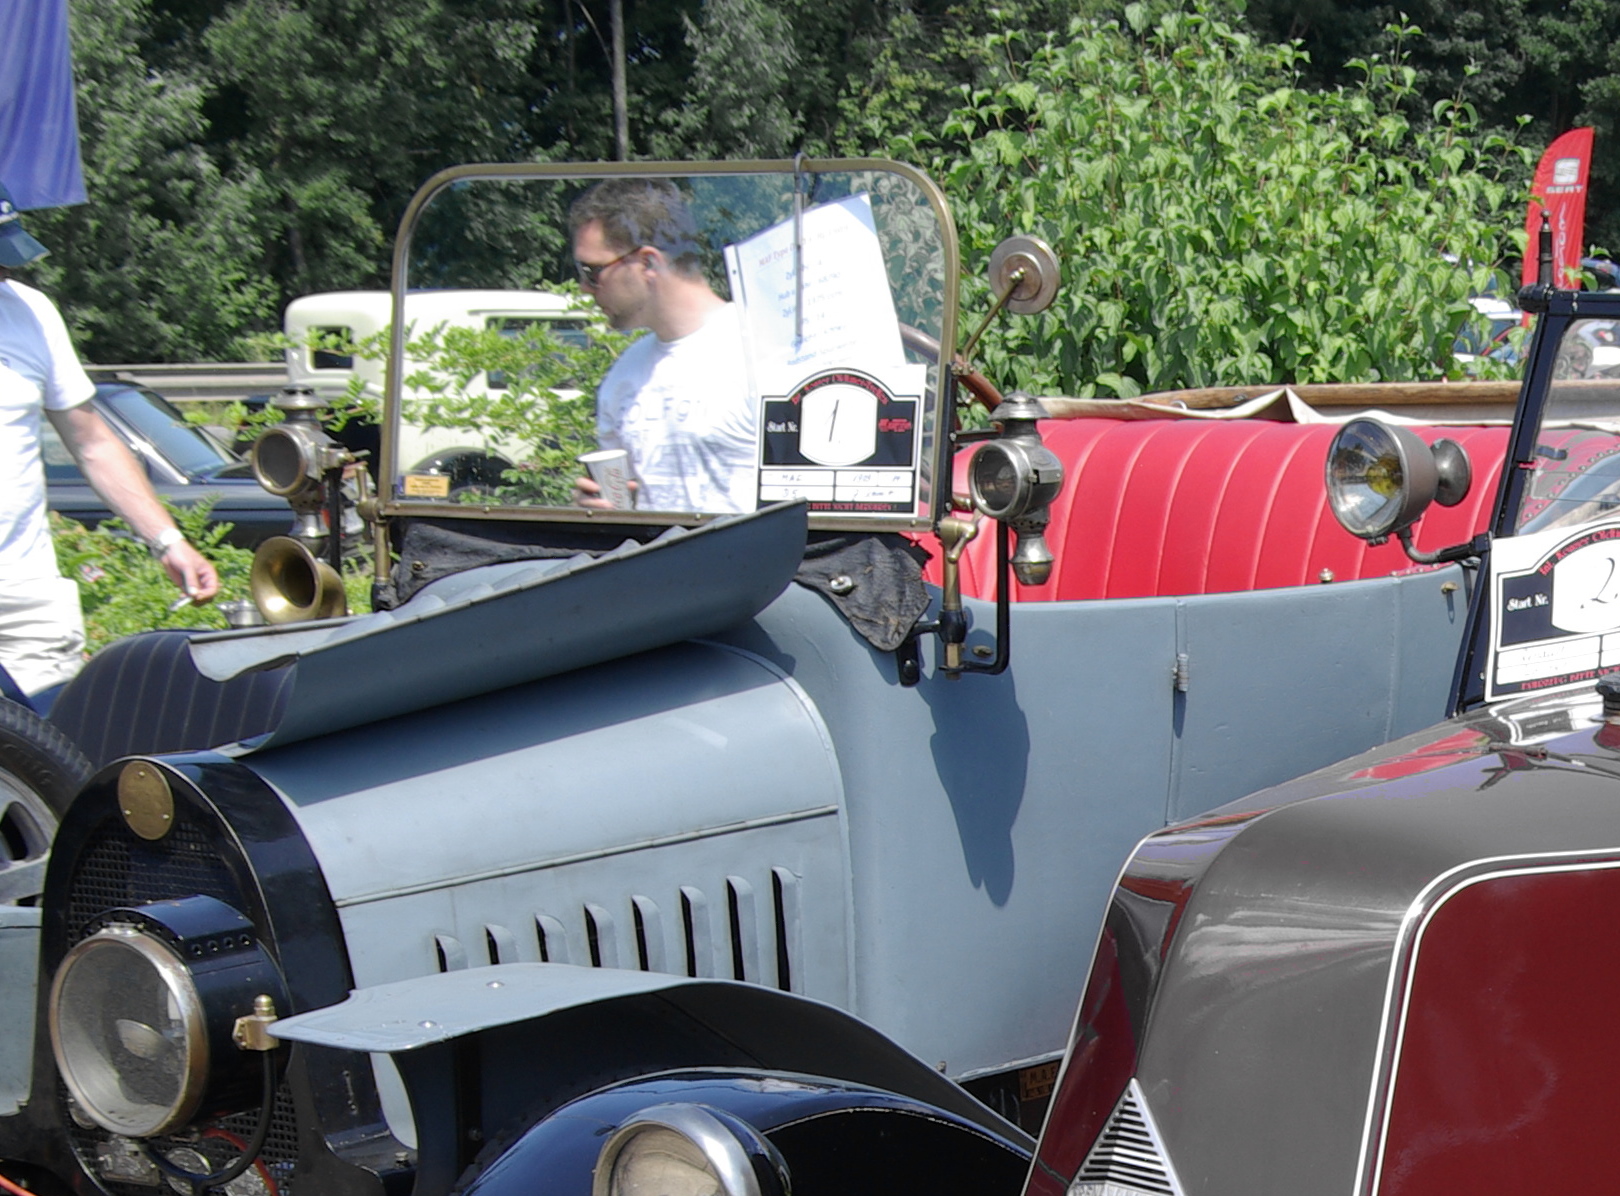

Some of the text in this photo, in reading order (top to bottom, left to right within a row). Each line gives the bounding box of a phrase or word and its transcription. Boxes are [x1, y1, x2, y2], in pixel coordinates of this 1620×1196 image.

[1546, 186, 1583, 194] SEAT
[767, 421, 785, 433] Start
[1590, 557, 1615, 604] 2
[1507, 593, 1549, 611] Start Nr.
